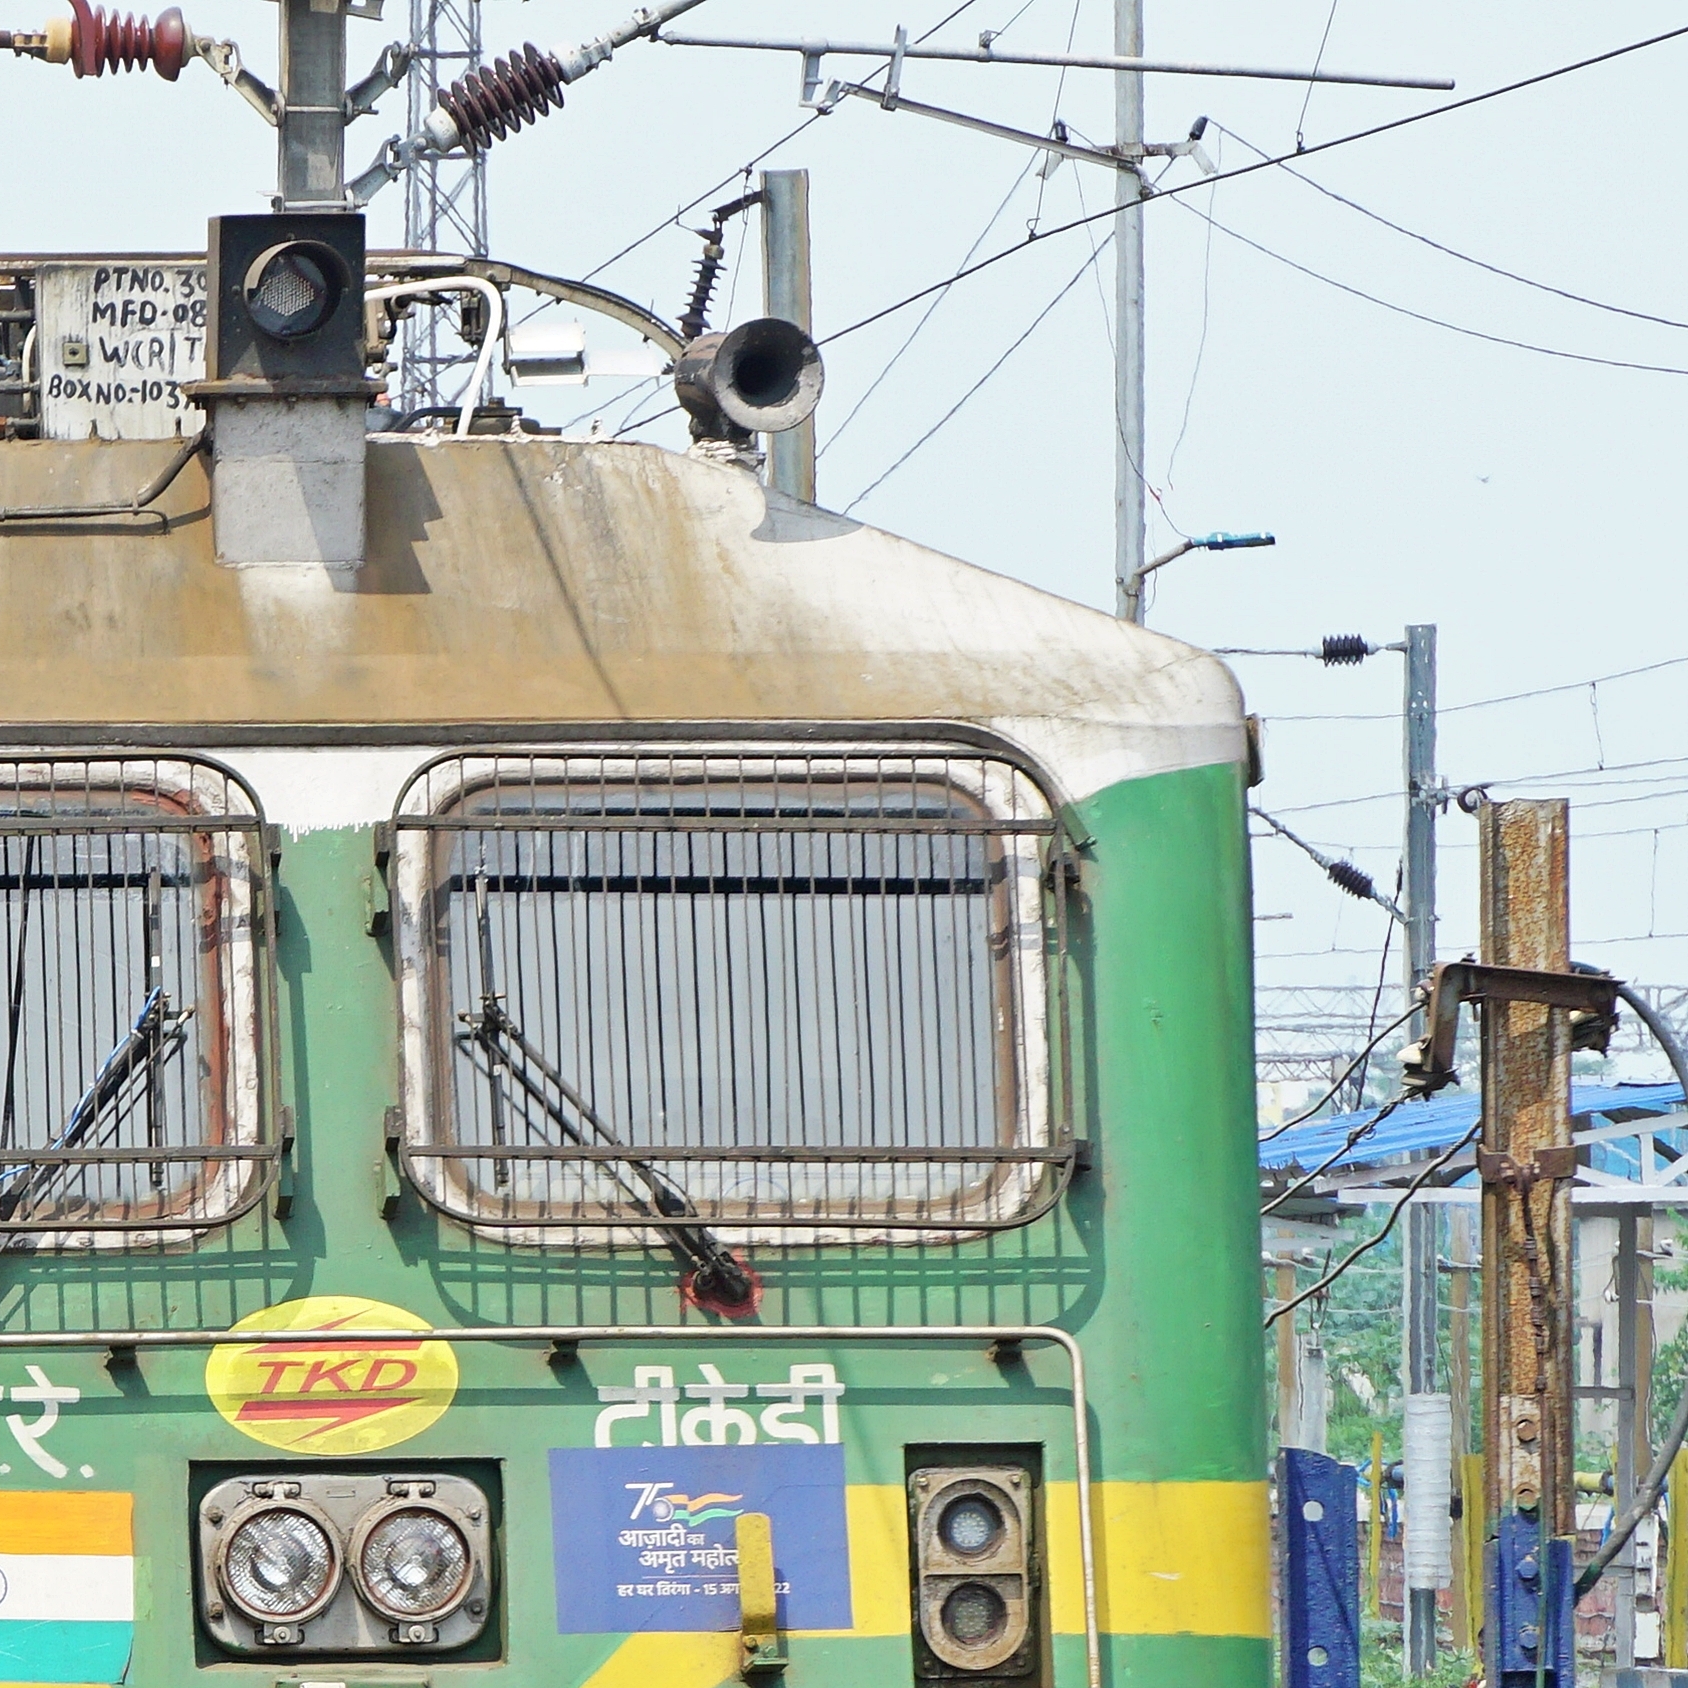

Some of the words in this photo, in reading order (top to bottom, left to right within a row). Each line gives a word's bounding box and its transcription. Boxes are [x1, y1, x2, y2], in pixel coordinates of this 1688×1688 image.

[257, 1358, 418, 1394] TKD
[687, 1532, 706, 1546] का
[638, 1549, 687, 1574] अमृत
[690, 1543, 741, 1570] महोत्
[617, 1583, 634, 1597] हर
[703, 1583, 718, 1596] 15
